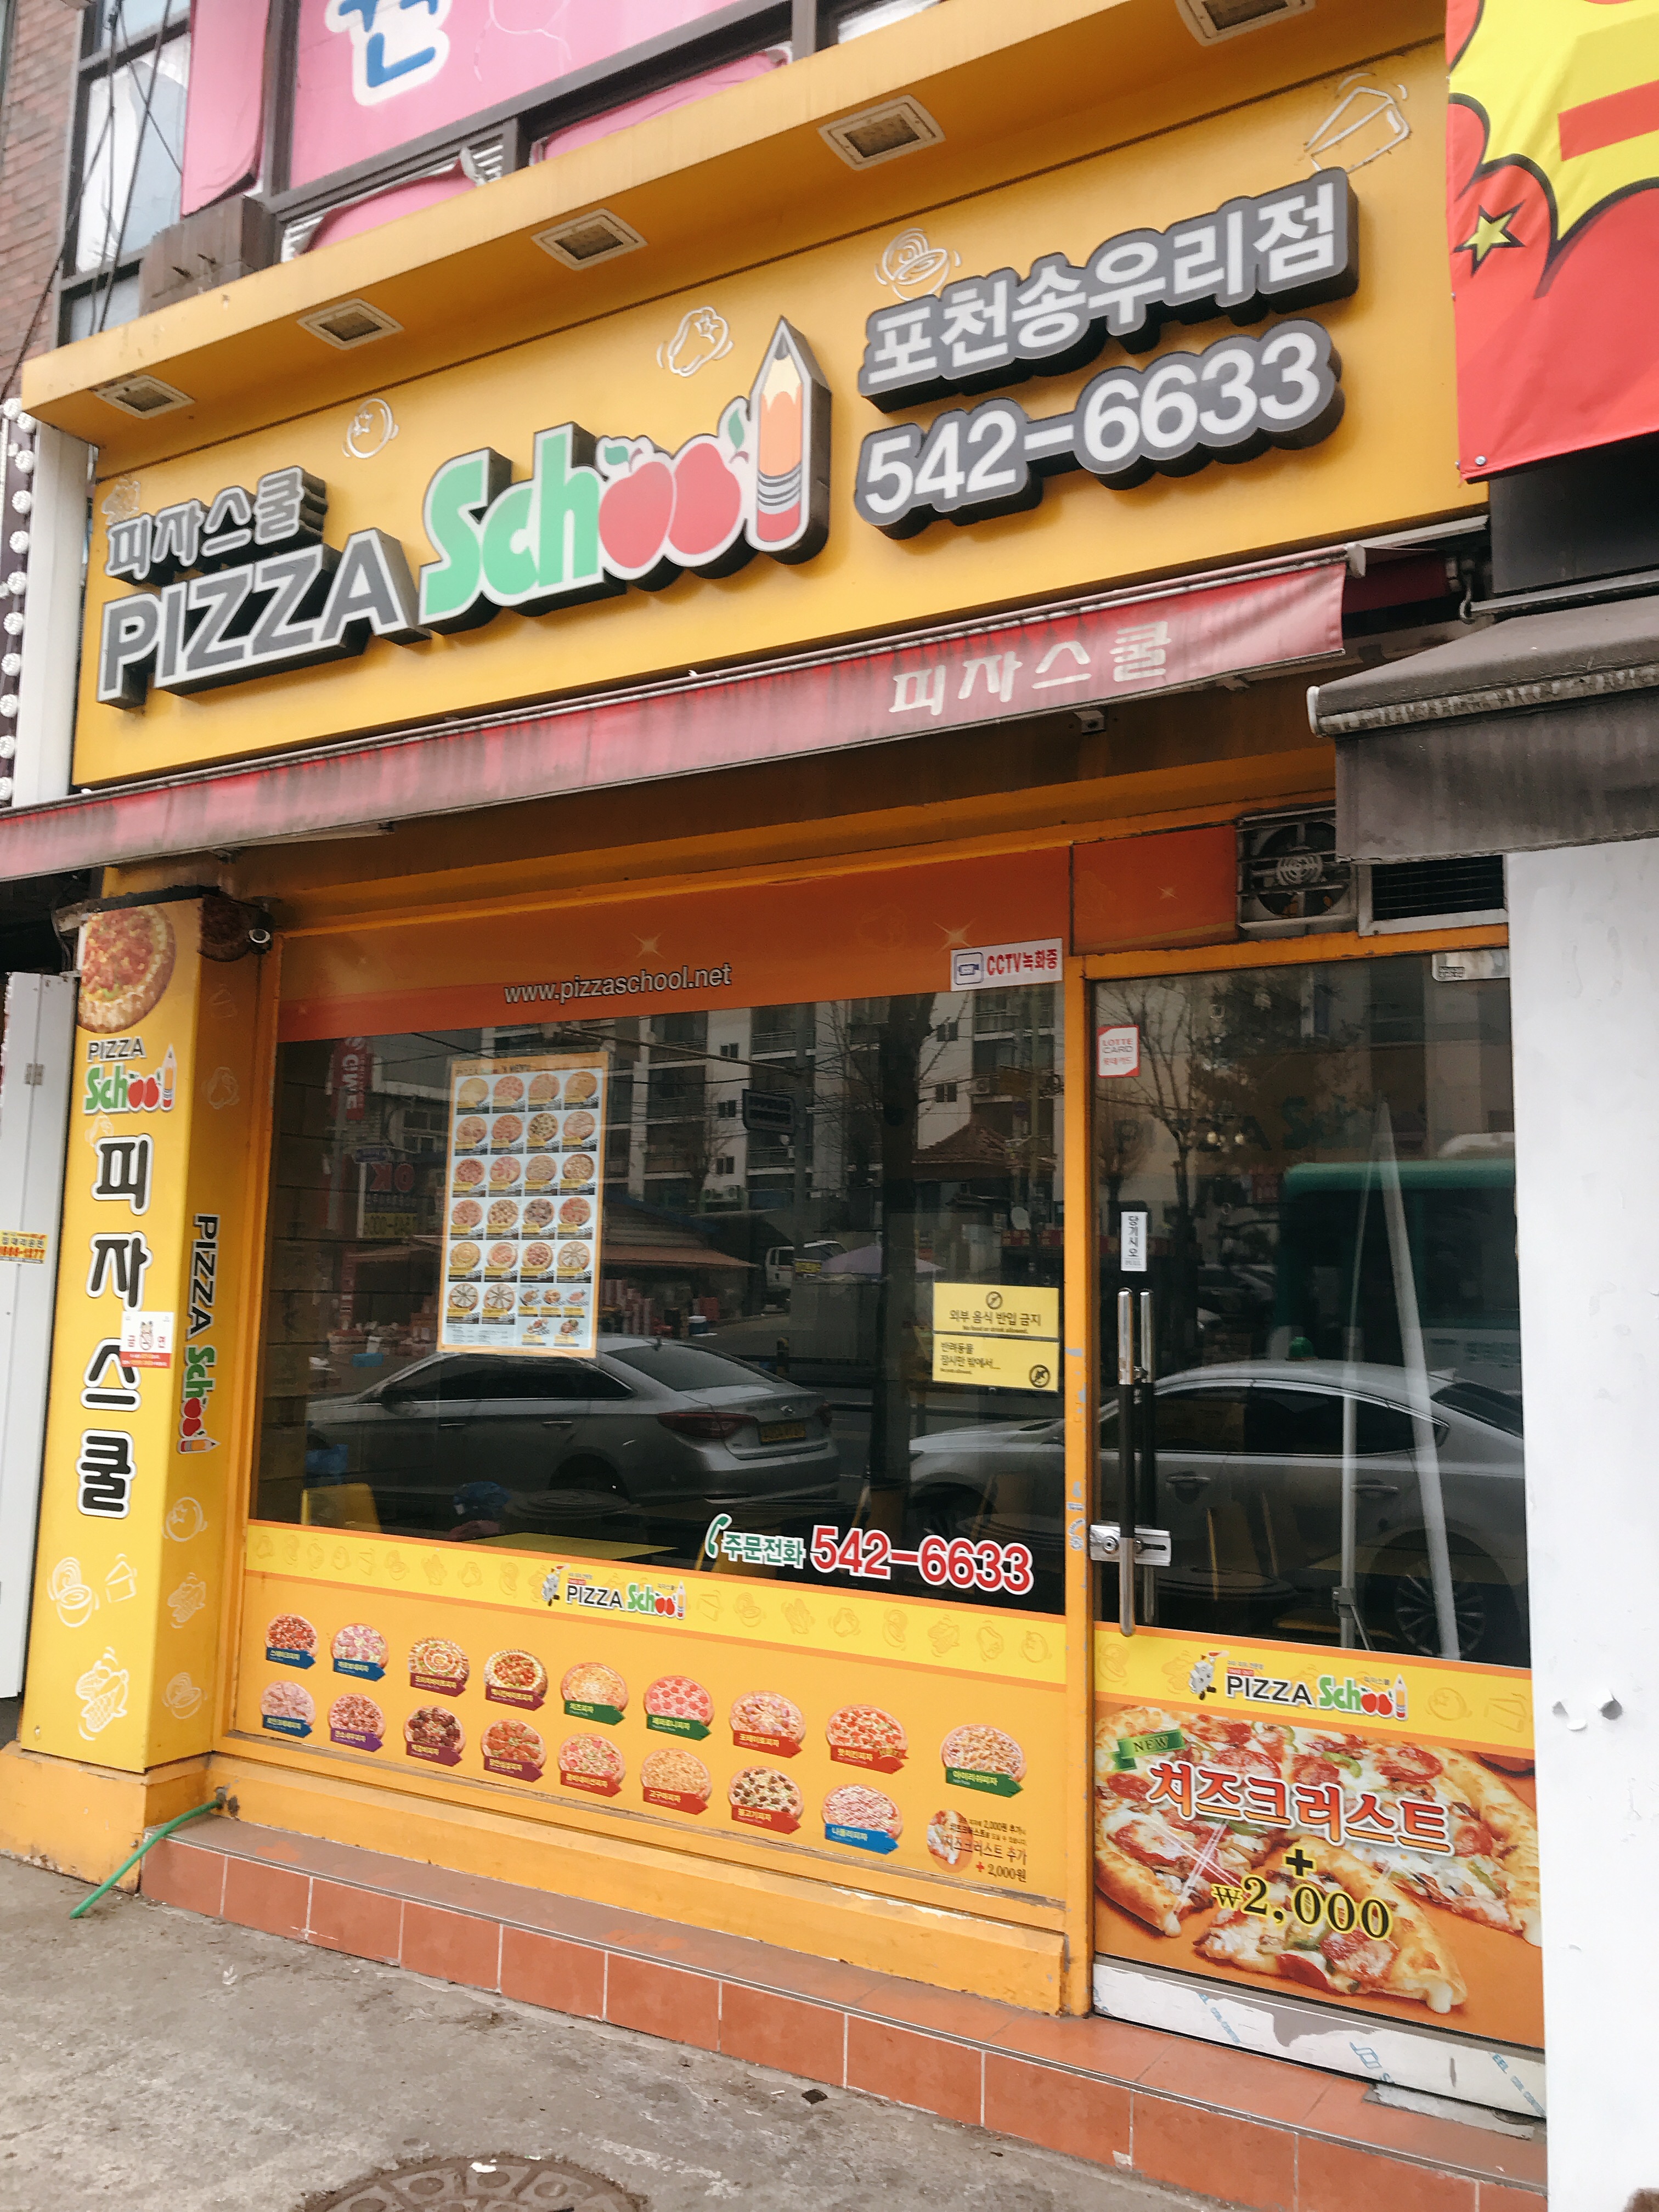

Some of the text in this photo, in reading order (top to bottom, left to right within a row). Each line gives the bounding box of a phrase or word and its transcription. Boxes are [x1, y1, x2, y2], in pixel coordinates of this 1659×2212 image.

[867, 181, 1336, 385] 포천송우리점
[864, 331, 1321, 515] 542-6633
[97, 315, 813, 704] PIZZA School
[106, 466, 306, 580] 피자스쿨
[889, 620, 1172, 715] 피자스쿨
[503, 962, 733, 1005] www.pizzaschool.net
[87, 1037, 147, 1063] PIZZA
[1102, 1038, 1133, 1046] LOTTE
[1102, 1045, 1132, 1054] CARD
[83, 1043, 177, 1115] School
[1128, 1216, 1139, 1257] 당기시오
[187, 1214, 219, 1340] PIZZA
[77, 1135, 154, 1519] 피자스쿨
[950, 1310, 1041, 1327] 외부 음식 반입 금지
[721, 1524, 1035, 1595] 주문전화 542-6633
[566, 1581, 686, 1620] PIZZA School
[1226, 1673, 1408, 1722] PIZZA School
[1132, 1735, 1170, 1754] NEW
[1147, 1760, 1457, 1858] 치즈크러스트
[987, 1863, 1027, 1883] 2,000원
